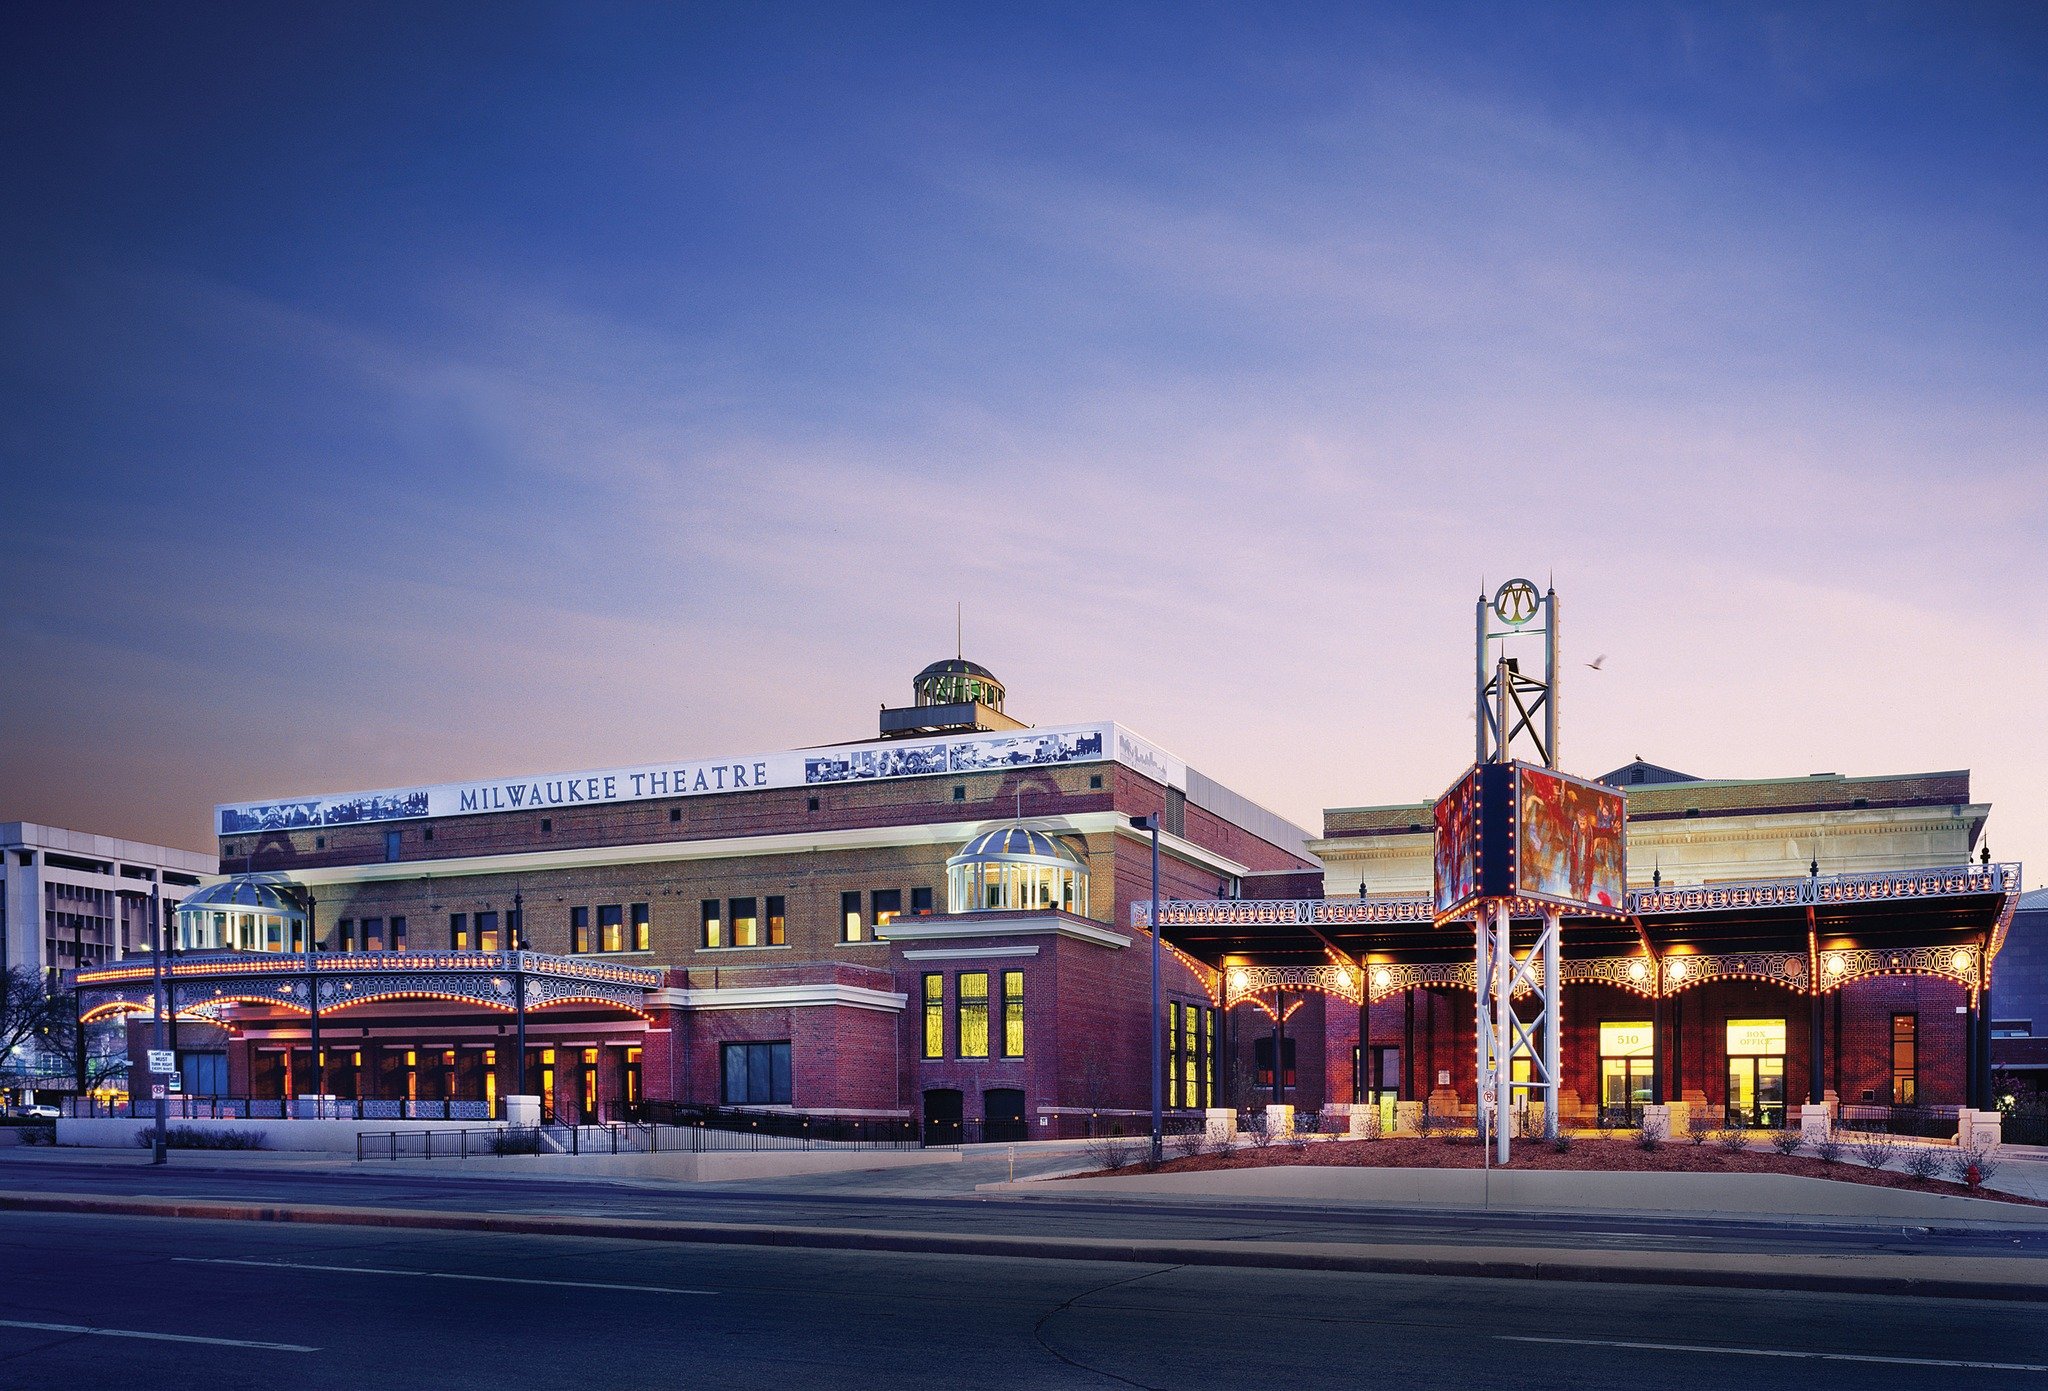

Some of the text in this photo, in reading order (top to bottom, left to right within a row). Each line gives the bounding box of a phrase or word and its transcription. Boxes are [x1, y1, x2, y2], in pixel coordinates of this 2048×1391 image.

[459, 762, 768, 811] MILWAUKEE THEATRE
[1617, 1035, 1639, 1044] 510
